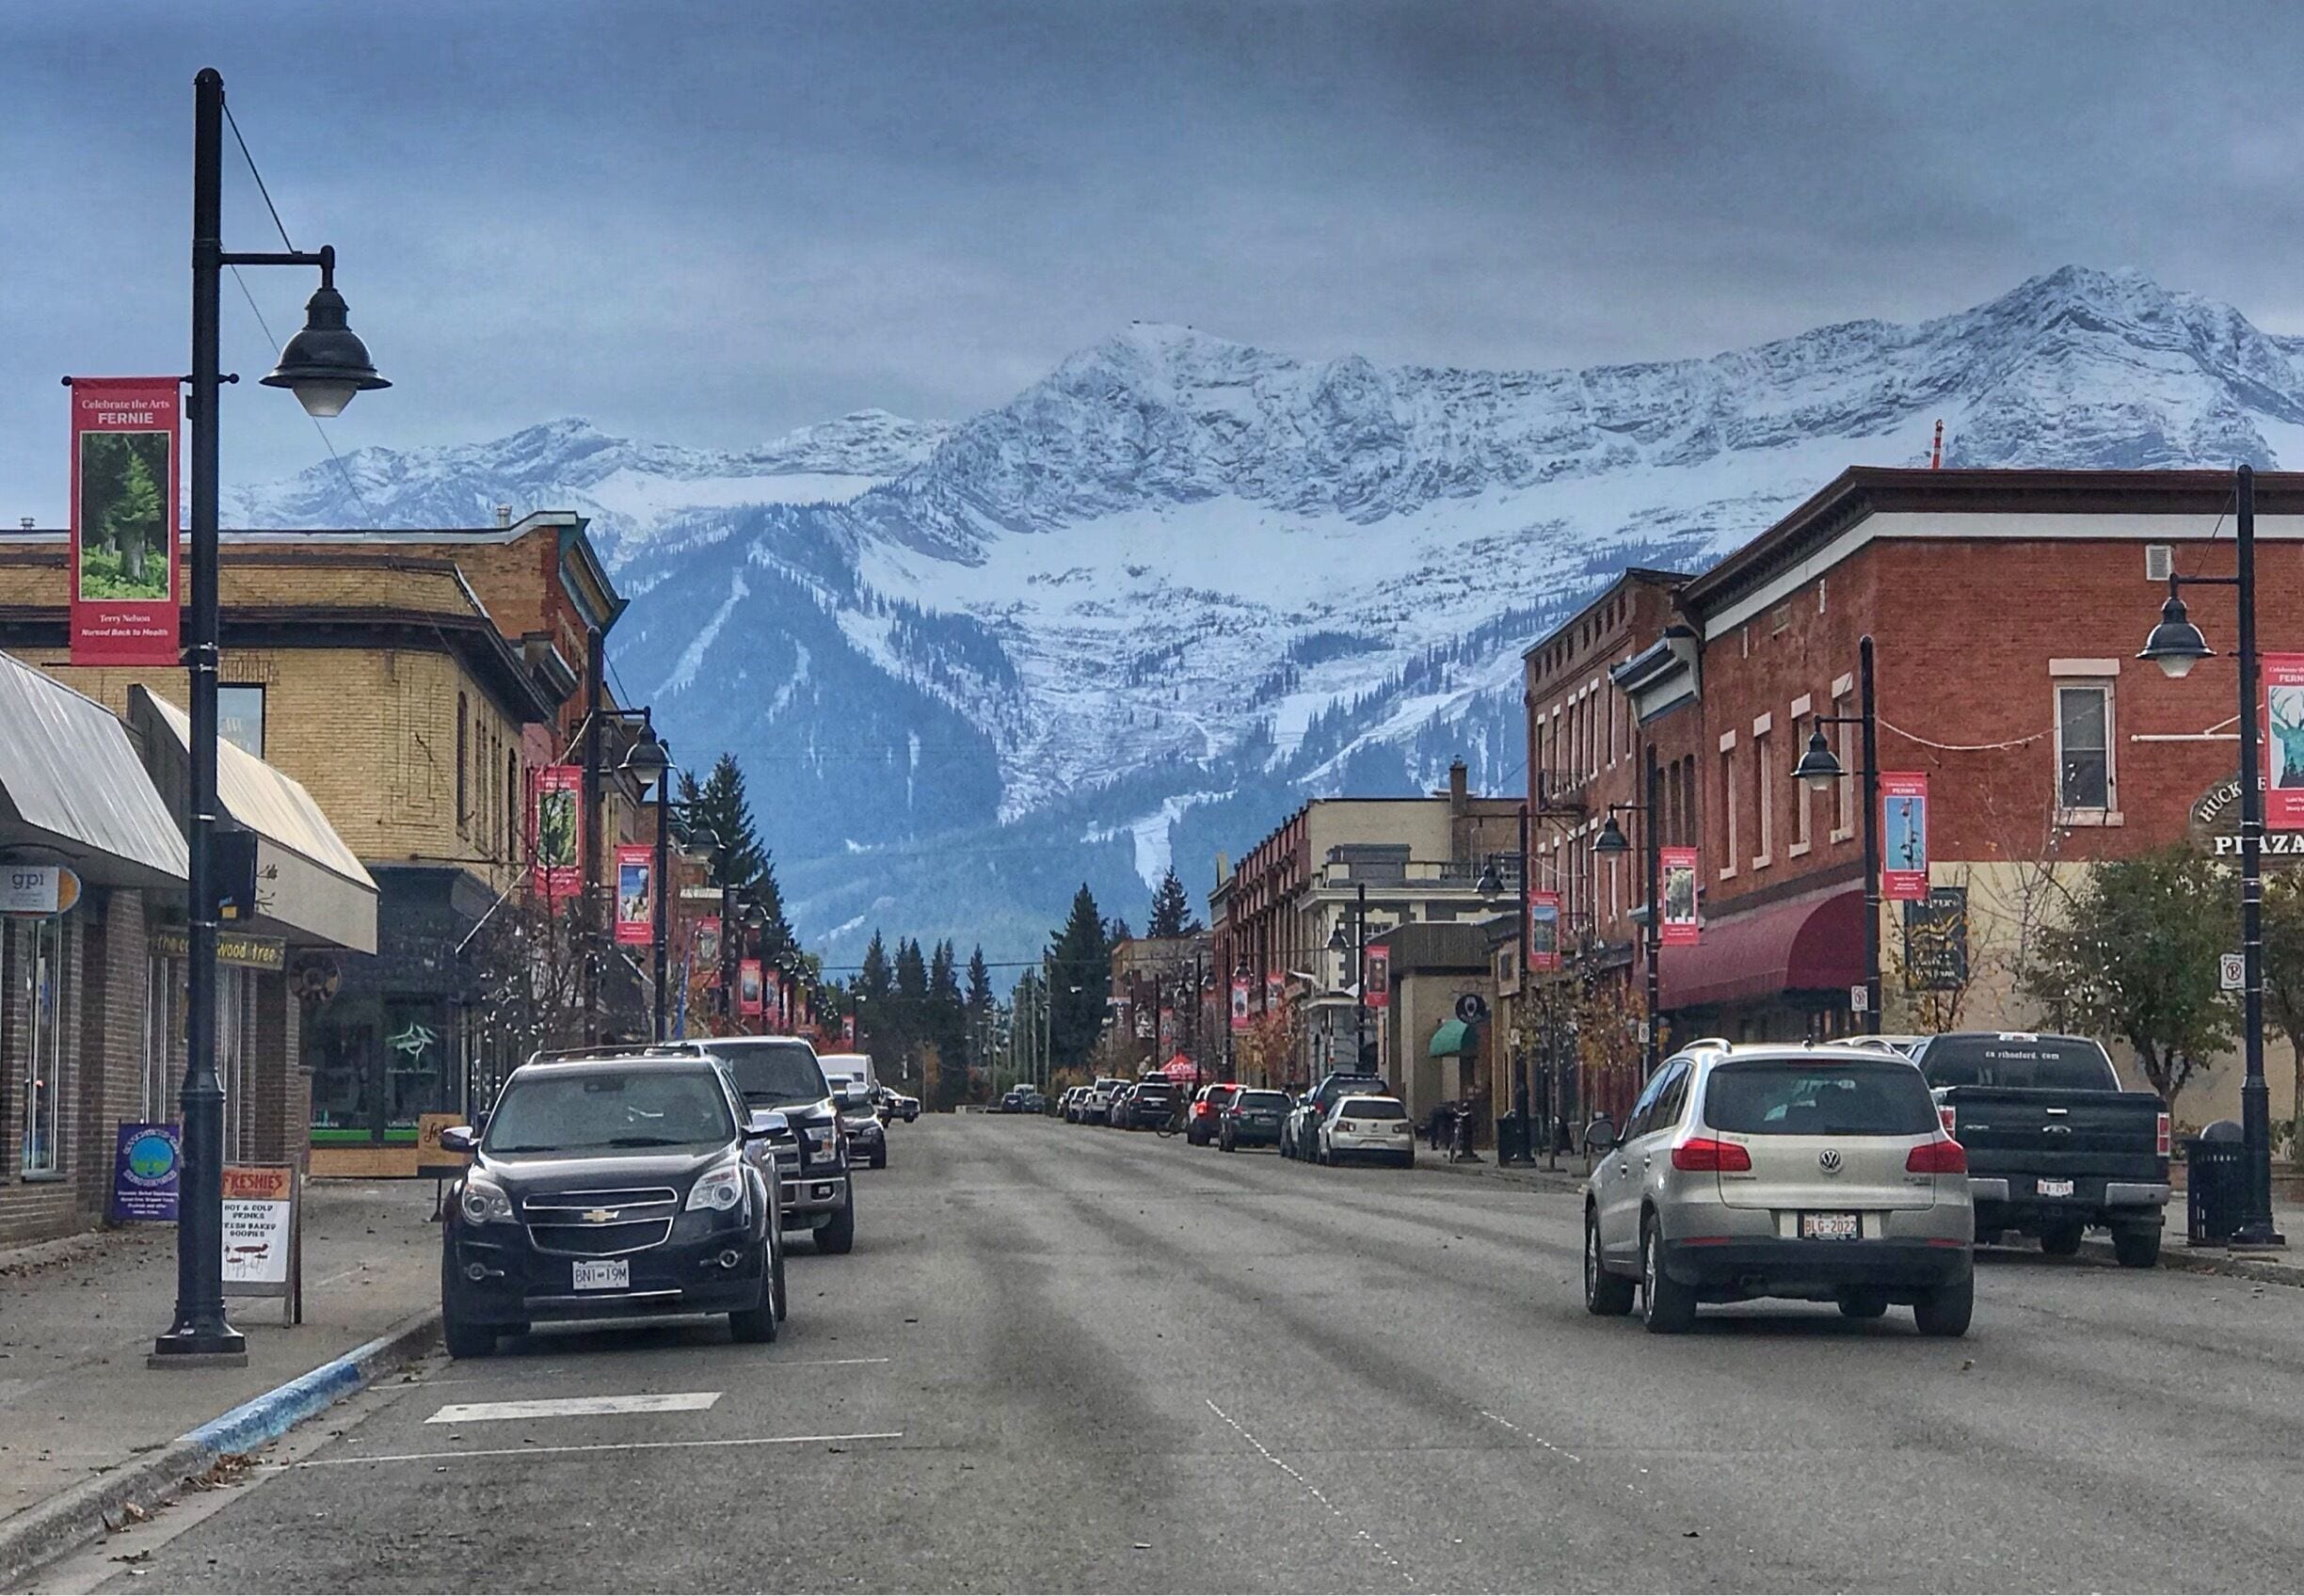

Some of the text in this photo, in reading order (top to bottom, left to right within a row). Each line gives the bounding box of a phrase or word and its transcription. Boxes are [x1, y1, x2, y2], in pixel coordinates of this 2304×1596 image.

[82, 399, 169, 409] Celebrate the Arts
[98, 412, 153, 423] FERNIE
[100, 614, 151, 624] Terry Nelson
[111, 628, 131, 636] Back
[11, 872, 44, 889] gpi
[252, 943, 277, 962] tree
